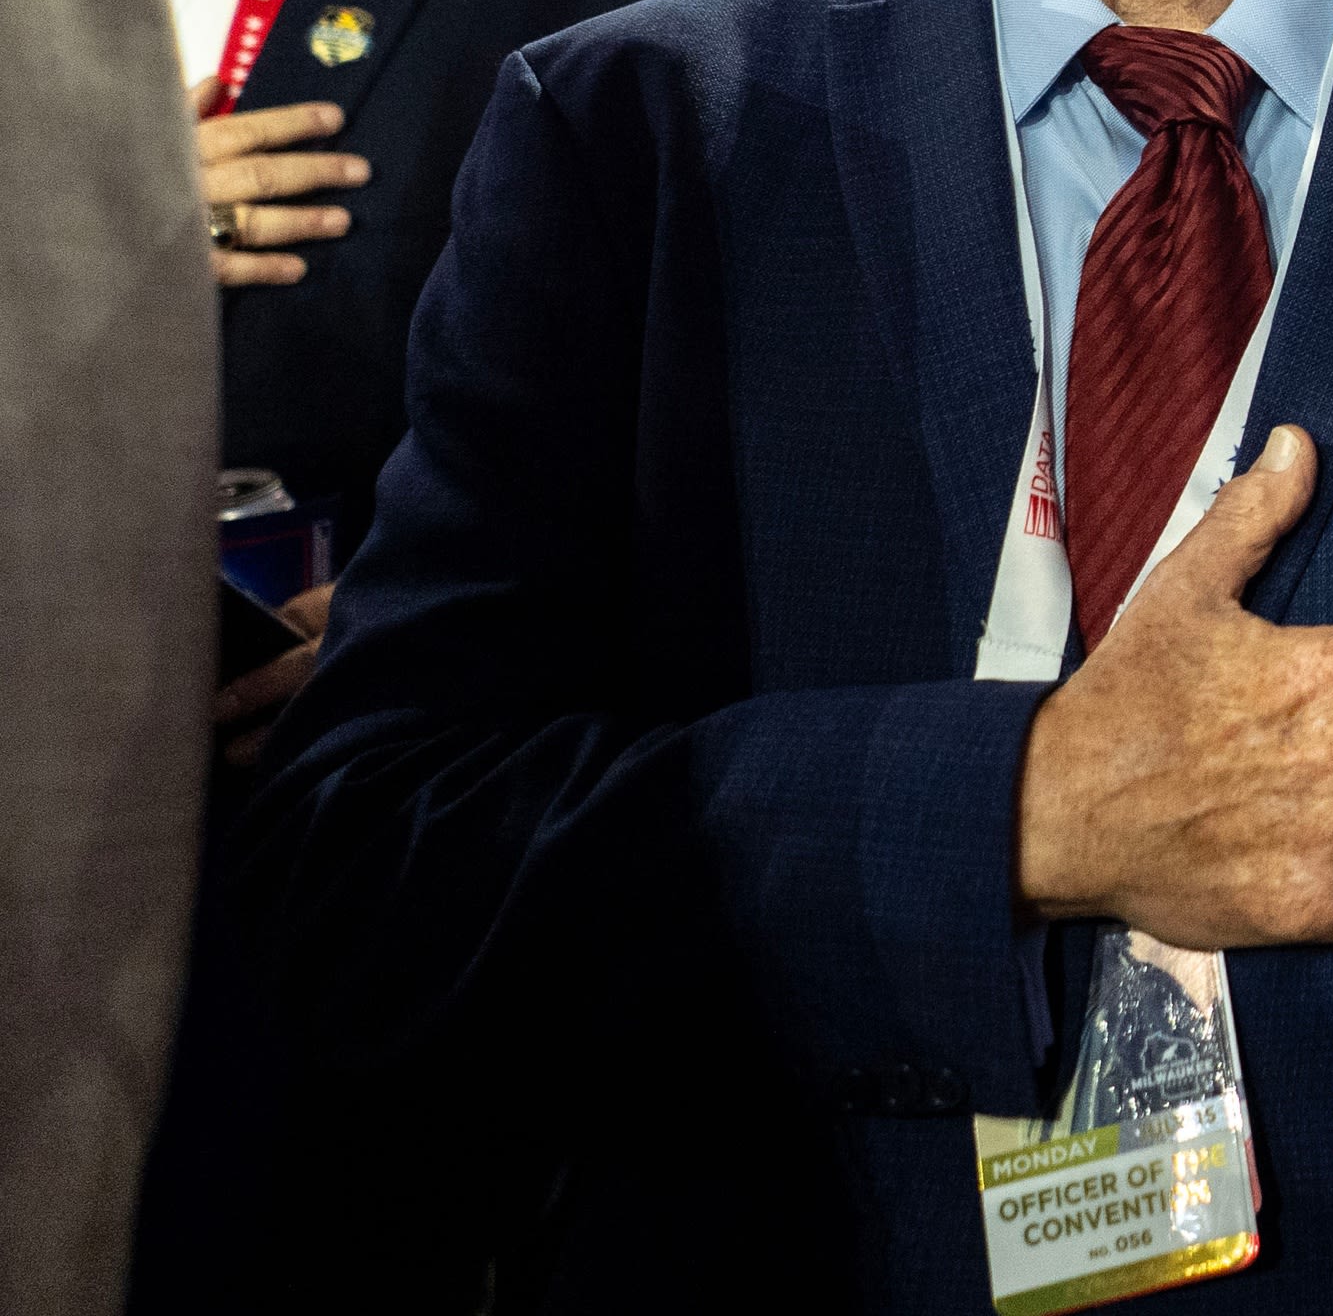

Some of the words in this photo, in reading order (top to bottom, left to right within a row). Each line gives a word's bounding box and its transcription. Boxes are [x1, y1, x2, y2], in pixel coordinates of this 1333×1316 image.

[1030, 430, 1053, 495] DATA
[992, 1136, 1099, 1180] MONDAY
[999, 1171, 1118, 1223] OFFICER
[1127, 1159, 1165, 1190] OF
[1023, 1179, 1211, 1247] CONVENTION
[1115, 1229, 1153, 1254] 056
